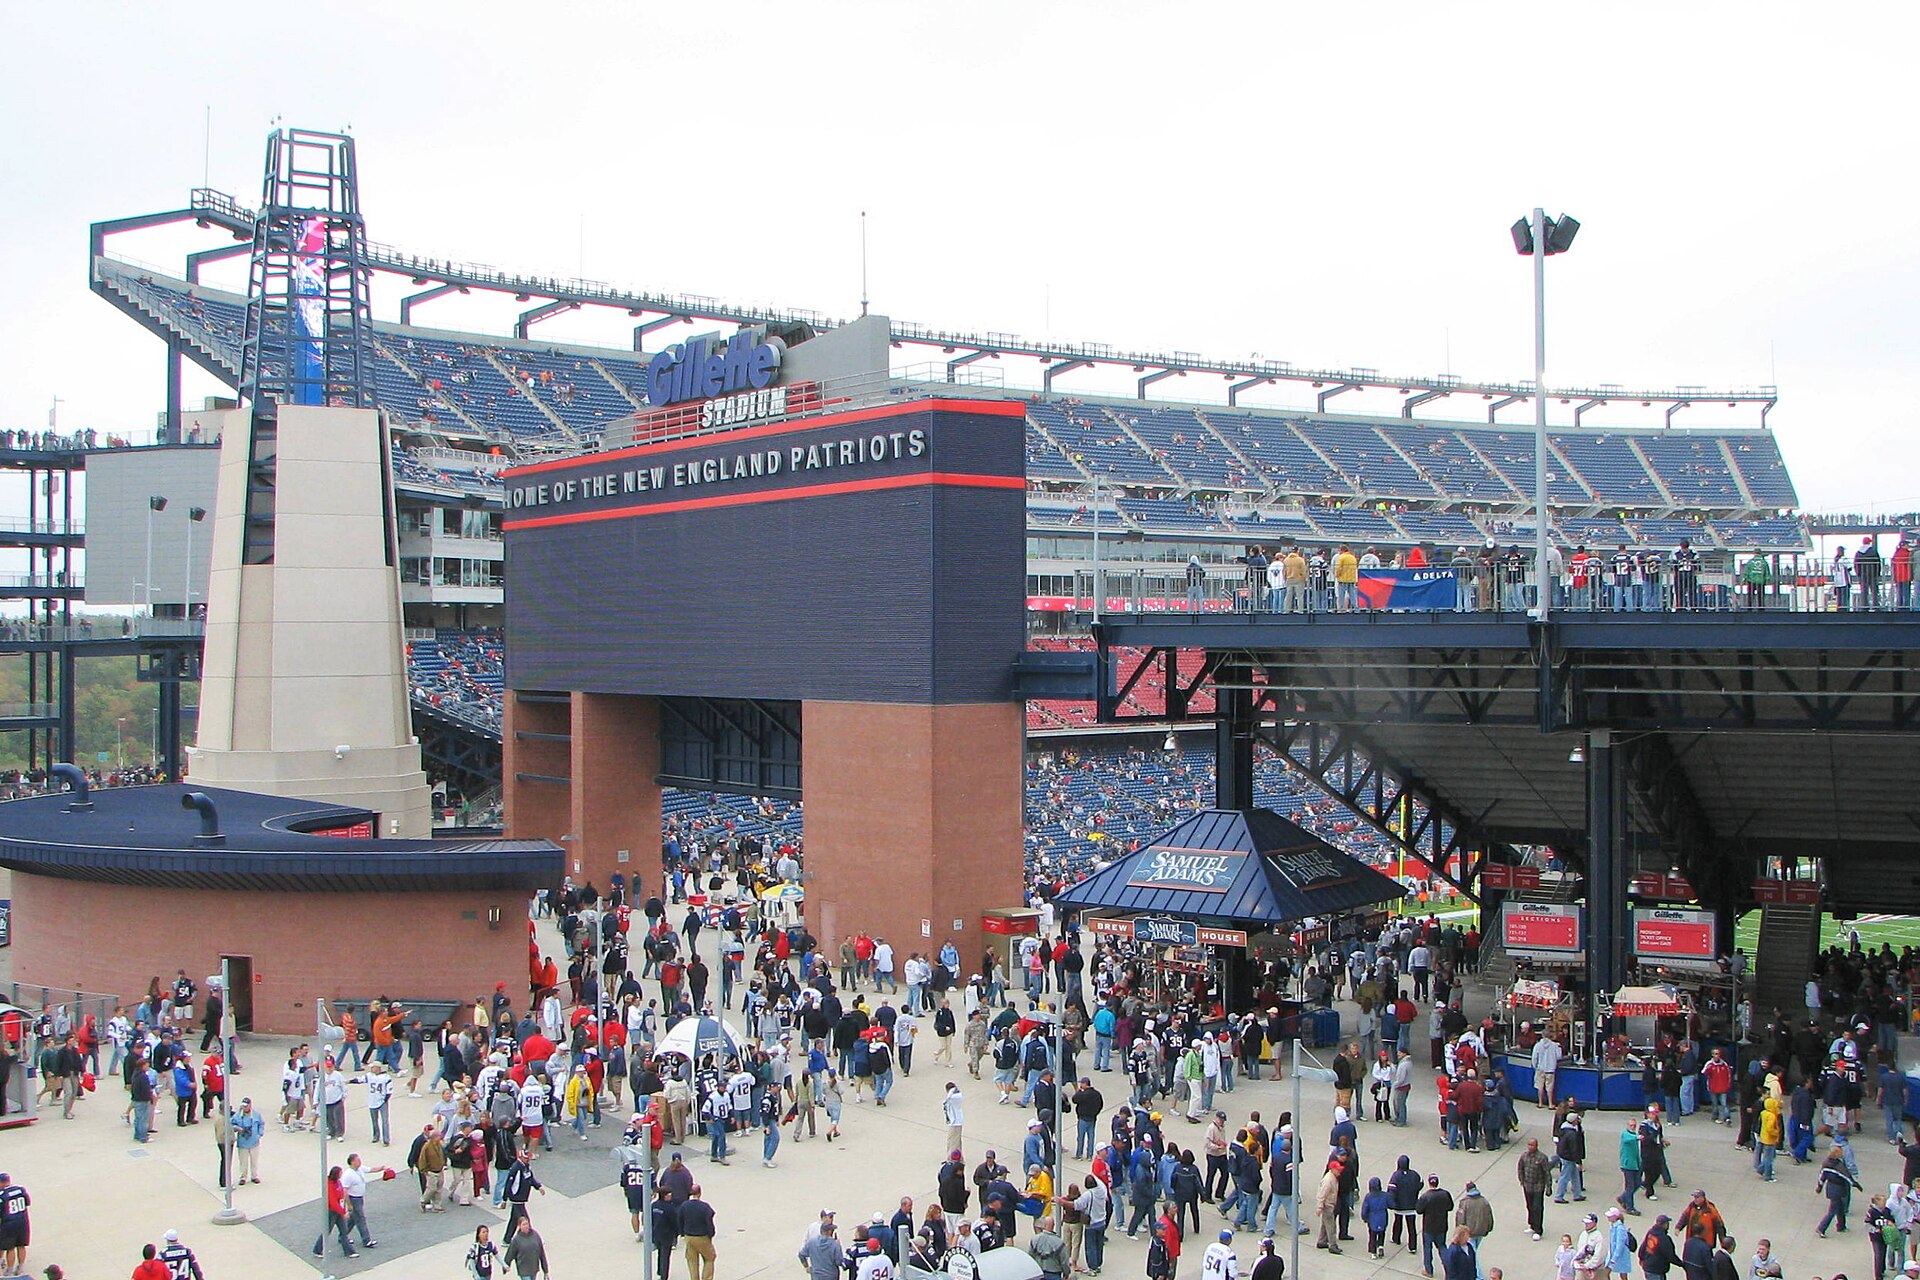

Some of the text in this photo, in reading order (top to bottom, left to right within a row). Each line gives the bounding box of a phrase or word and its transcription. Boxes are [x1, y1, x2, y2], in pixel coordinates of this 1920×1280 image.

[648, 329, 781, 407] Gillette
[701, 386, 787, 427] STADIUM
[502, 429, 926, 509] HOME OF THE NEW ENGLAND PATRIOTS
[1422, 571, 1454, 580] DELTA
[1151, 851, 1229, 873] SAMUEL
[1277, 849, 1333, 872] SAMUEL
[1147, 866, 1217, 886] ADAMS
[1296, 860, 1343, 885] ADAMS
[1522, 904, 1550, 912] Gillette
[1654, 911, 1684, 919] Gillette
[1097, 922, 1128, 932] BREW
[1148, 921, 1183, 935] SAMUEL
[1150, 930, 1181, 943] ADAMS
[1201, 932, 1239, 942] HOUSE
[370, 1082, 383, 1094] 54
[703, 1080, 718, 1092] 12
[737, 1083, 750, 1096] 12
[525, 1095, 541, 1108] 96
[9, 1197, 26, 1214] 80
[1204, 1255, 1221, 1274] 54
[871, 1266, 888, 1280] 34
